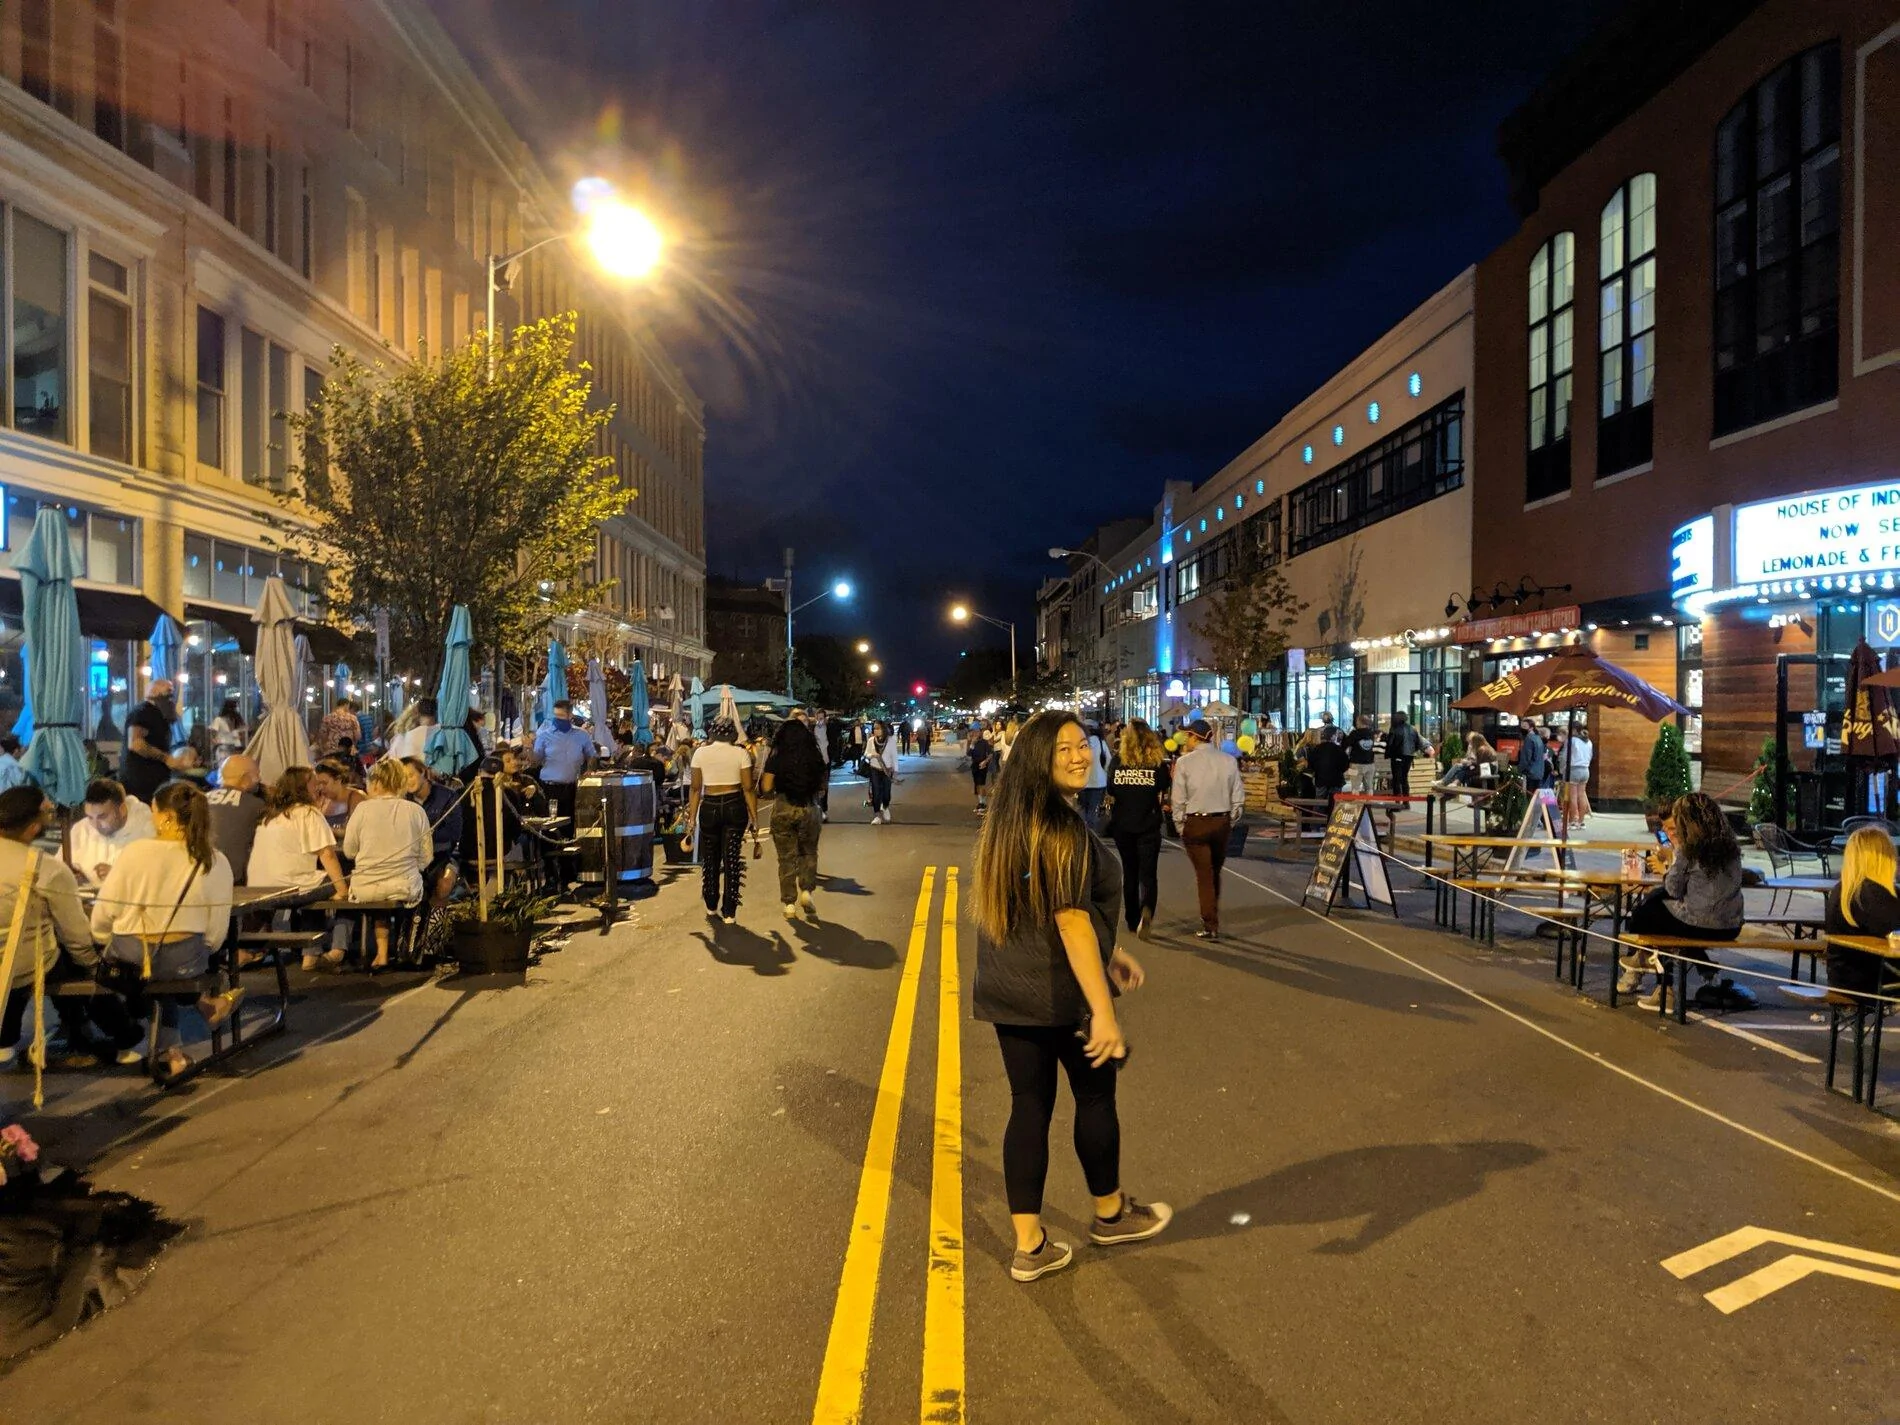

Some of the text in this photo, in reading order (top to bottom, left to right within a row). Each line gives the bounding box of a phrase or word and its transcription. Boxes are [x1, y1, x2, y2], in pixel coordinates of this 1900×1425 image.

[1777, 498, 1830, 519] HOUSE
[1838, 494, 1861, 511] OF
[1819, 522, 1860, 539] NOW
[1762, 550, 1849, 574] LEMONADE
[1859, 547, 1870, 563] &
[1113, 777, 1156, 786] OUTDOORS
[1114, 769, 1156, 777] BARRETT
[205, 788, 242, 807] SA
